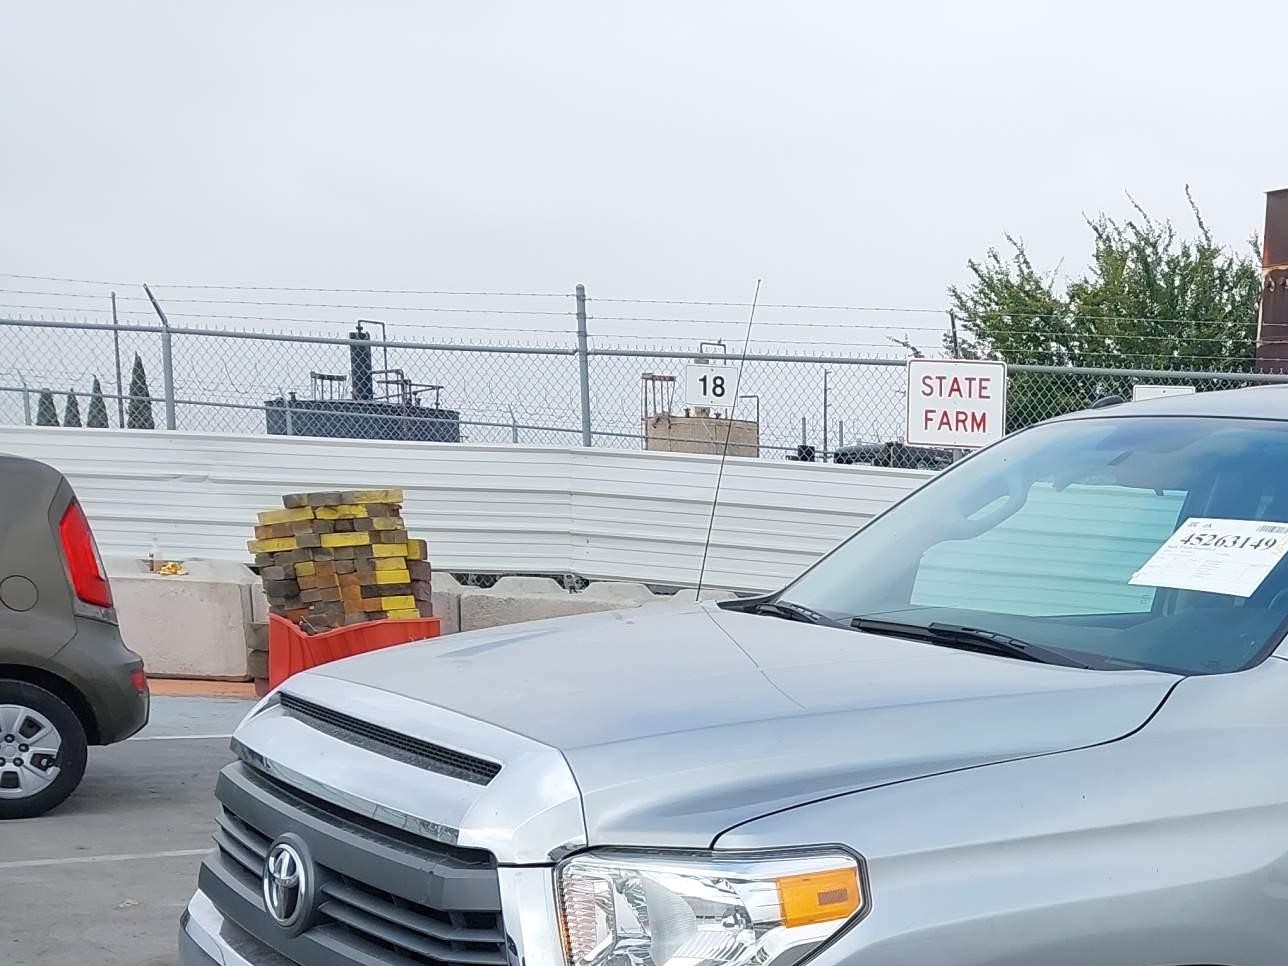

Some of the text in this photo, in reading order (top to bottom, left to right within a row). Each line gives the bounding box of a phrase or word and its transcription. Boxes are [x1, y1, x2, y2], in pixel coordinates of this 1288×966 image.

[698, 375, 726, 398] 18
[921, 375, 991, 399] STATE
[924, 409, 987, 433] FARM
[1179, 532, 1278, 551] 45263149
